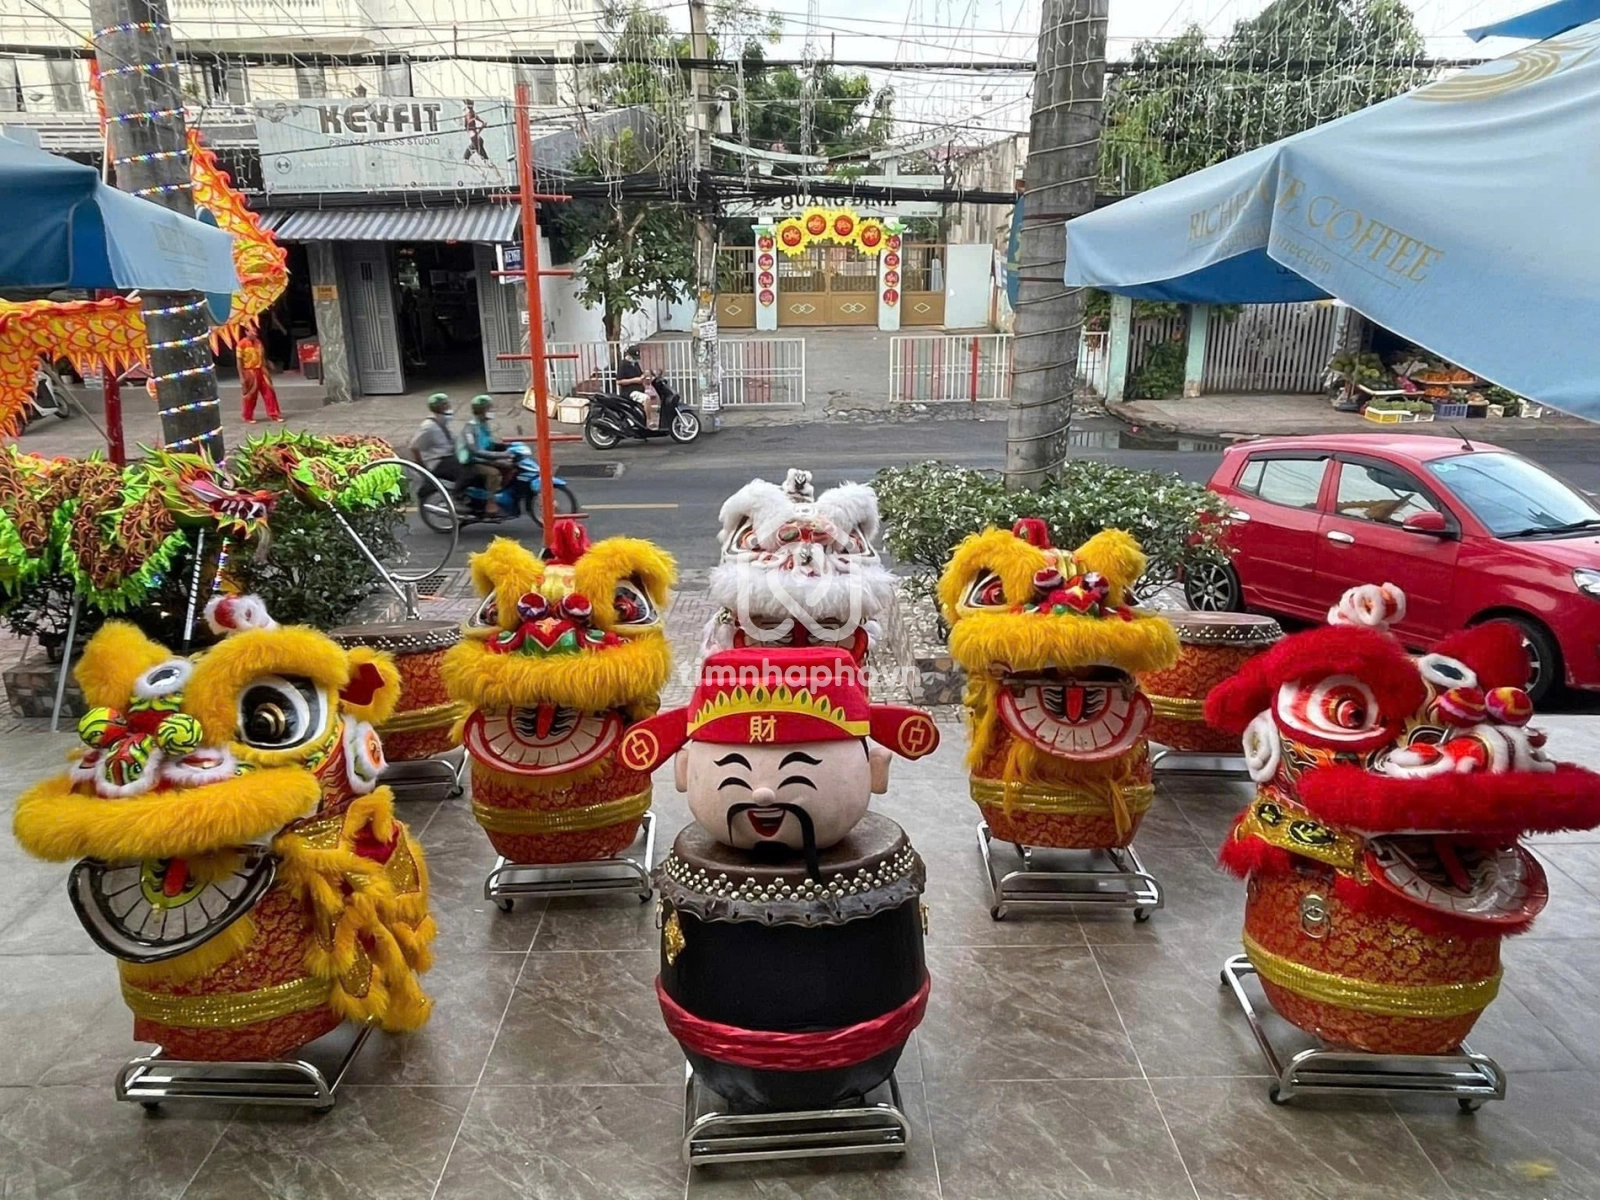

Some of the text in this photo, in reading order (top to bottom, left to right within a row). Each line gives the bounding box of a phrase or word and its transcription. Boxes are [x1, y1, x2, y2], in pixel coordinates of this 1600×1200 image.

[318, 103, 441, 134] KEYFIT
[407, 137, 440, 146] STUDIO
[1306, 195, 1445, 282] COFFEE
[749, 714, 777, 743] 財
